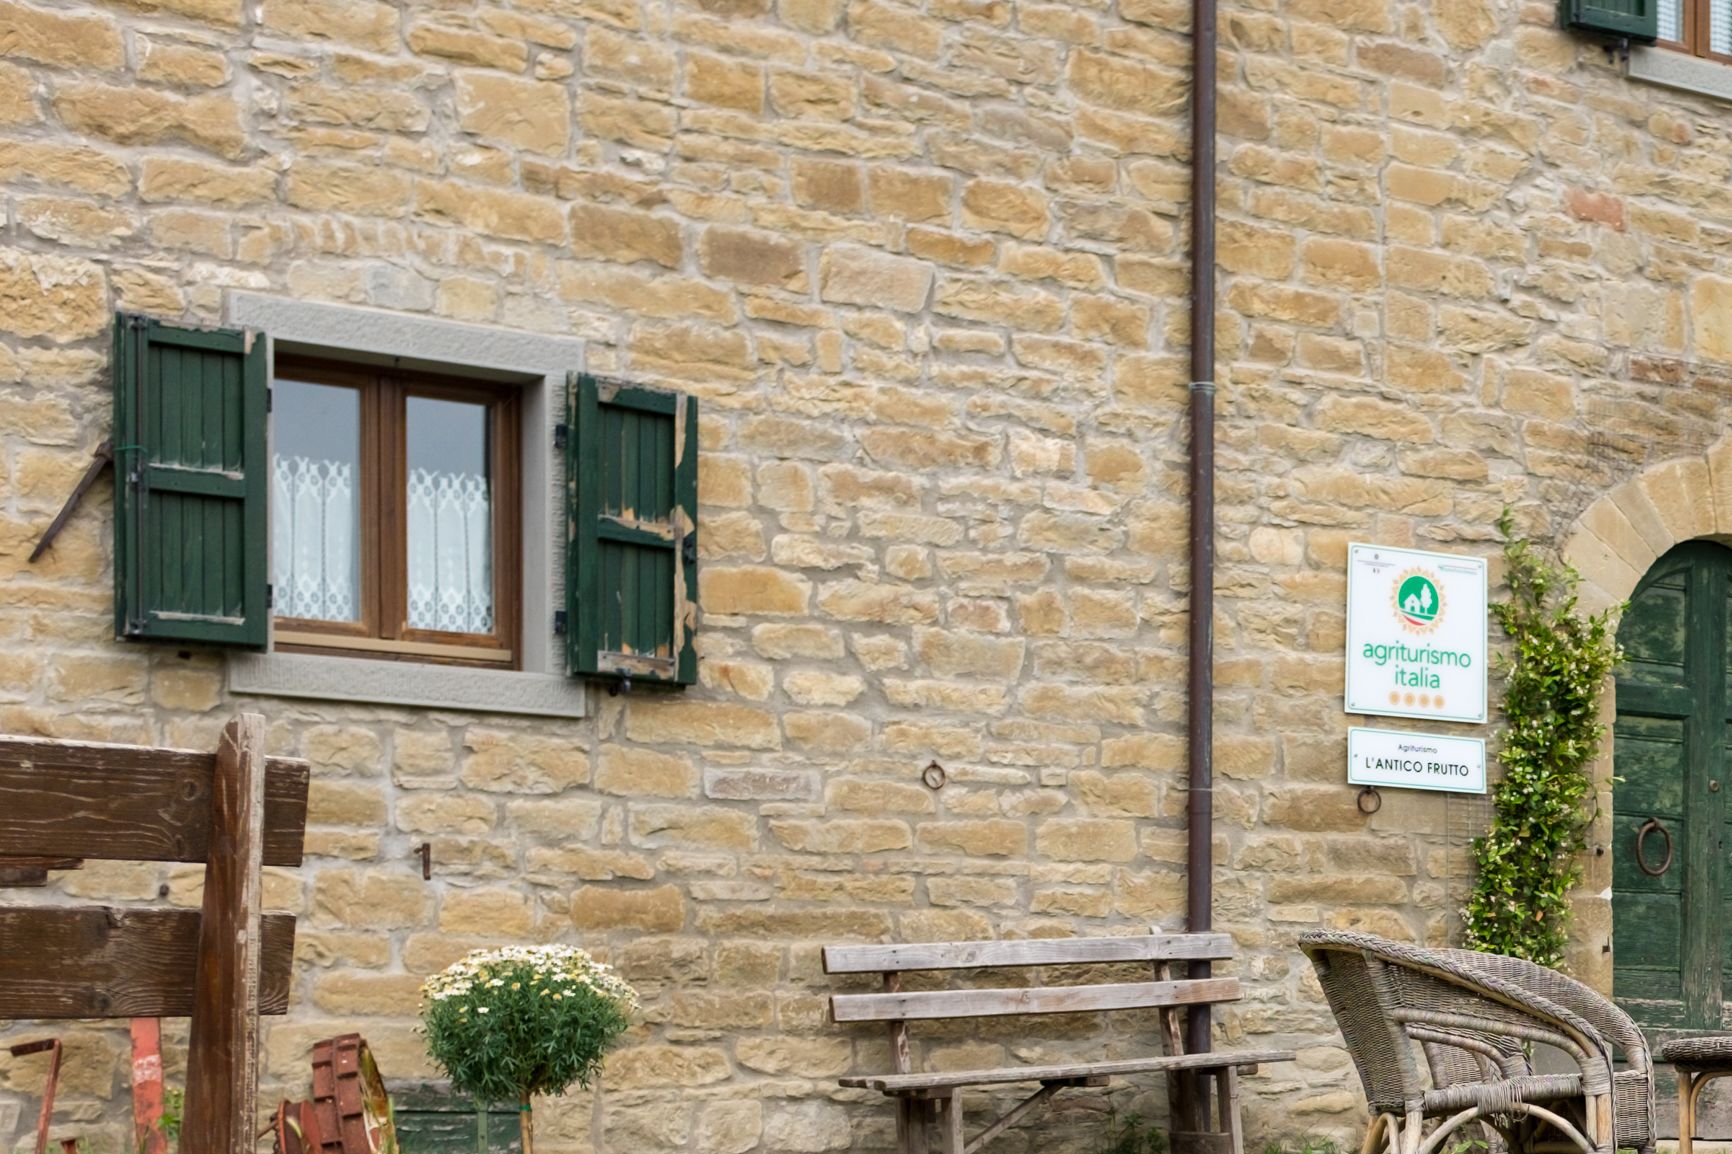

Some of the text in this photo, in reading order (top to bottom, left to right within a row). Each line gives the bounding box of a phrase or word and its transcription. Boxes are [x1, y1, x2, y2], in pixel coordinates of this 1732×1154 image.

[1363, 640, 1471, 668] agriturismo
[1394, 664, 1441, 689] italia
[1398, 744, 1438, 754] Agriturismo
[1365, 757, 1469, 777] L'ANTICO FRUTTO
